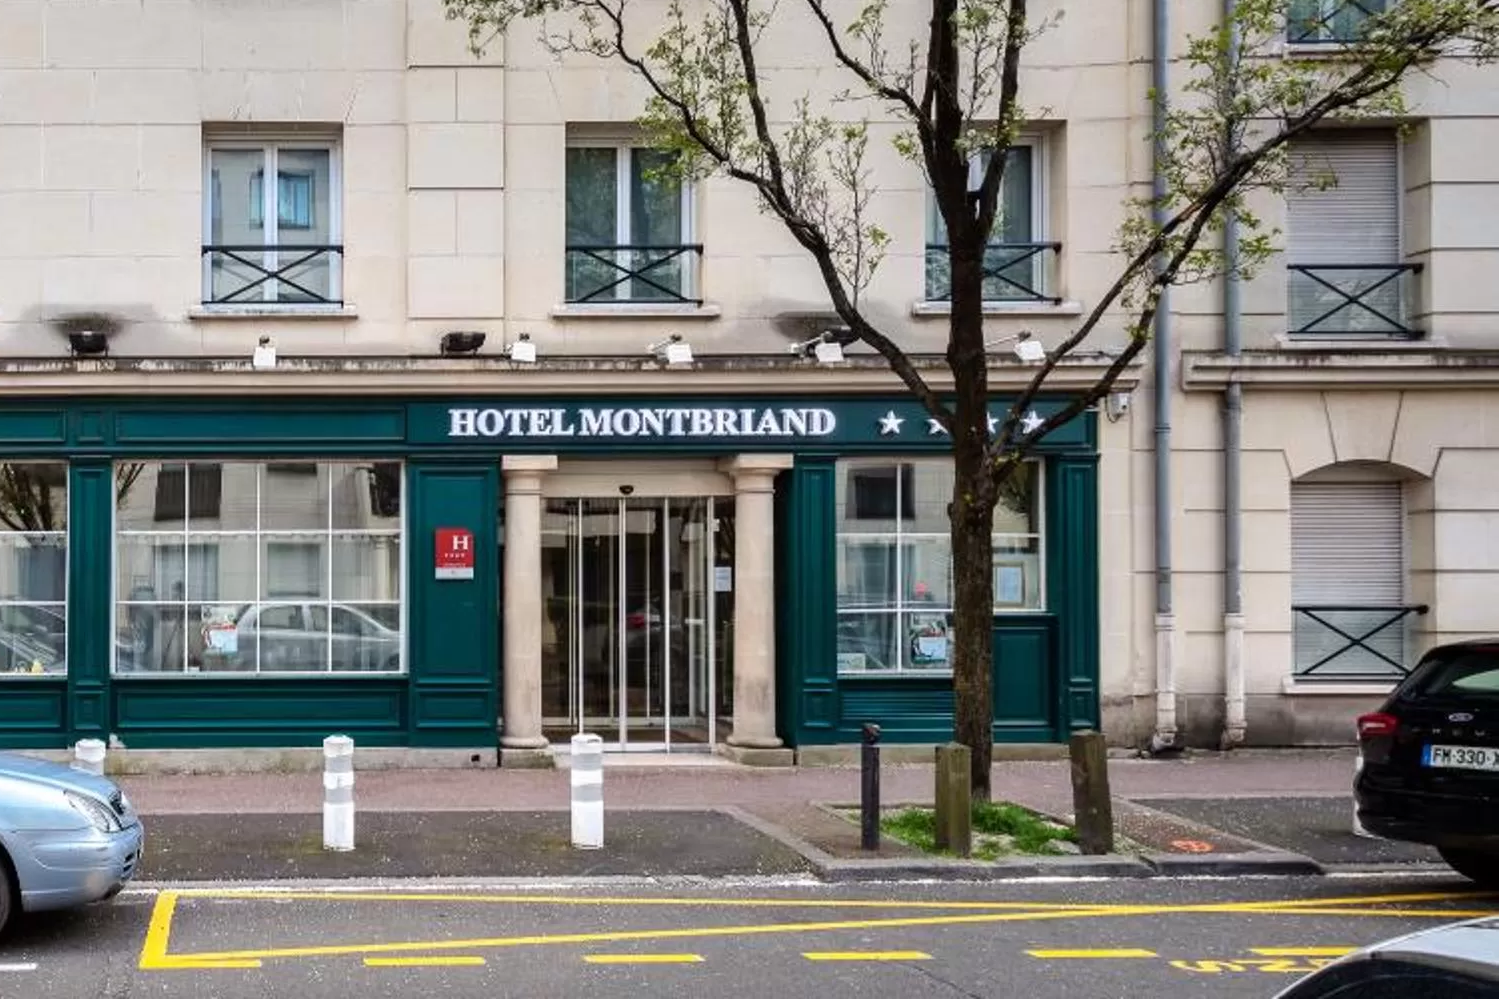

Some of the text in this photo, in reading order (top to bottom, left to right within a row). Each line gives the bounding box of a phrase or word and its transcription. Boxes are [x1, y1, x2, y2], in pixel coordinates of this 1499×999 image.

[447, 408, 837, 437] HOTEL MONTBRIAND
[453, 535, 469, 550] H
